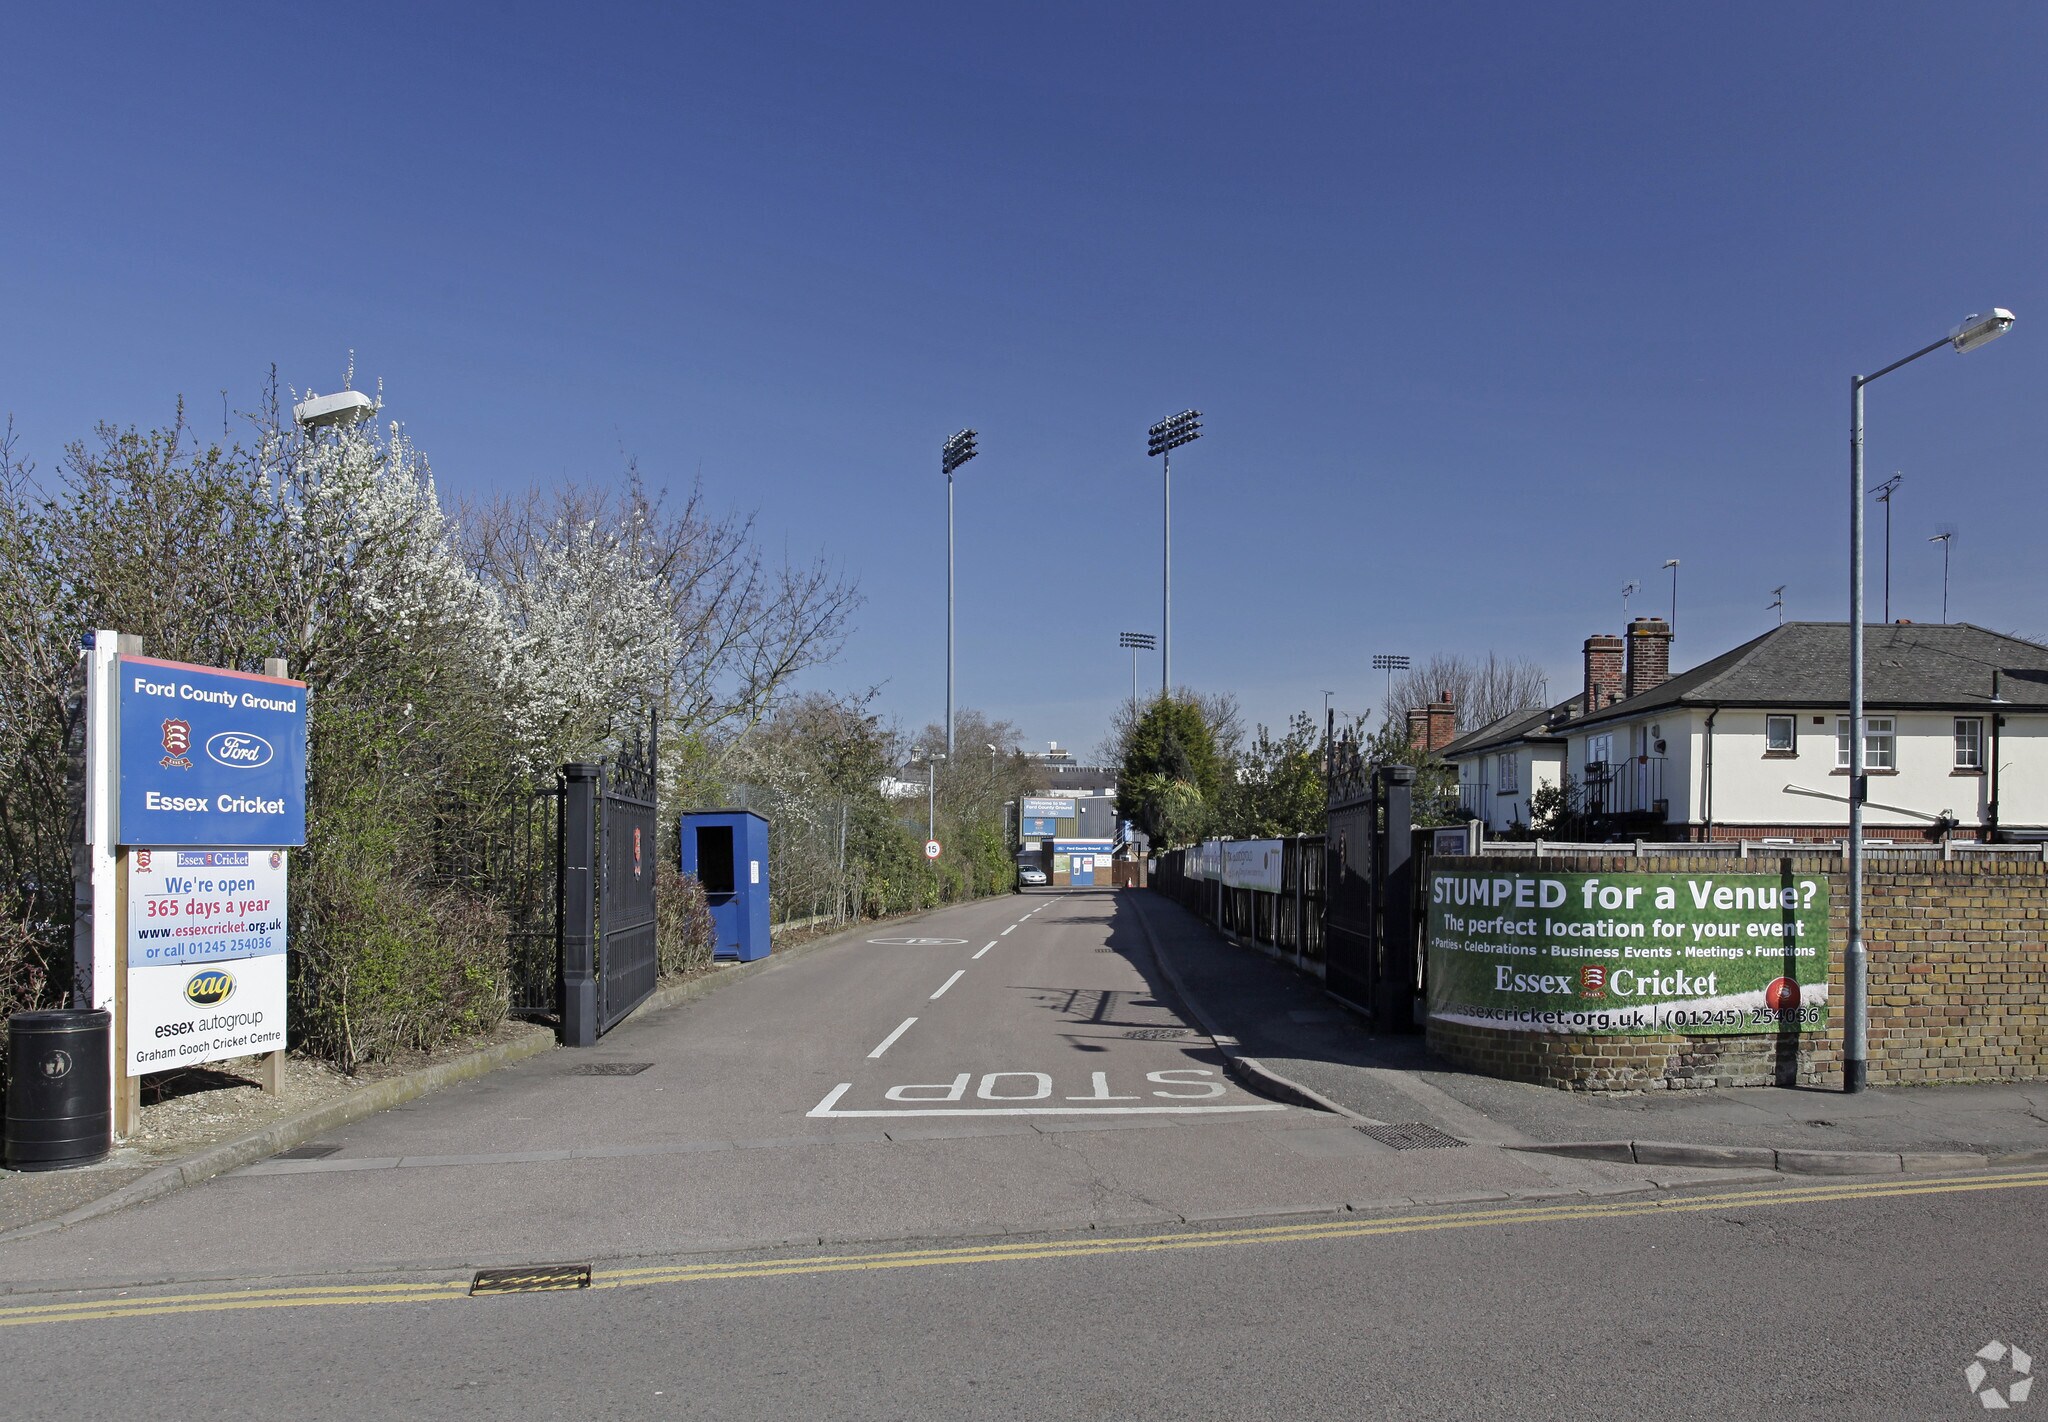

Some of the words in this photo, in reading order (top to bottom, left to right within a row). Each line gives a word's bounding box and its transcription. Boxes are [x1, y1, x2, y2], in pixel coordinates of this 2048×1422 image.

[134, 678, 175, 698] Ford
[180, 684, 238, 708] County
[242, 693, 296, 713] Ground
[220, 736, 260, 762] Ford
[146, 792, 208, 812] Essex
[217, 795, 284, 814] Cricket
[178, 852, 204, 866] Essex
[214, 852, 248, 866] Cricket
[165, 877, 213, 893] We're
[218, 877, 255, 896] open
[1433, 876, 1567, 908] STUMPED
[1581, 879, 1642, 910] for
[1654, 885, 1675, 910] a
[1688, 880, 1817, 910] Venue?
[147, 900, 179, 917] 365
[185, 898, 220, 919] days
[226, 901, 235, 914] a
[239, 898, 270, 917] year
[138, 918, 281, 939] www.essexcricket.org.uk
[1444, 914, 1464, 931] The
[1468, 916, 1537, 936] perfect
[1546, 918, 1644, 937] location
[1652, 919, 1685, 937] for
[1692, 922, 1740, 941] your
[1746, 921, 1804, 937] event
[146, 946, 160, 958] or
[164, 942, 184, 957] call
[189, 940, 226, 955] 01245
[231, 936, 272, 952] 254036
[1435, 938, 1458, 950] Parties
[1464, 940, 1536, 956] Celebrations
[1551, 946, 1619, 958] Business
[1624, 947, 1672, 958] Events
[1685, 946, 1744, 959] Meetings
[1755, 946, 1816, 957] Functions
[1495, 965, 1573, 994] Essex
[1610, 969, 1717, 996] Cricket
[155, 1019, 195, 1039] essex
[198, 1010, 263, 1036] autogroup
[1665, 1009, 1744, 1028] (01245)
[1751, 1008, 1819, 1024] 254036
[136, 1046, 176, 1063] Graham
[179, 1040, 210, 1056] Gooch
[213, 1035, 248, 1050] Cricket
[250, 1031, 281, 1044] Centre
[885, 1069, 1227, 1101] STOP
